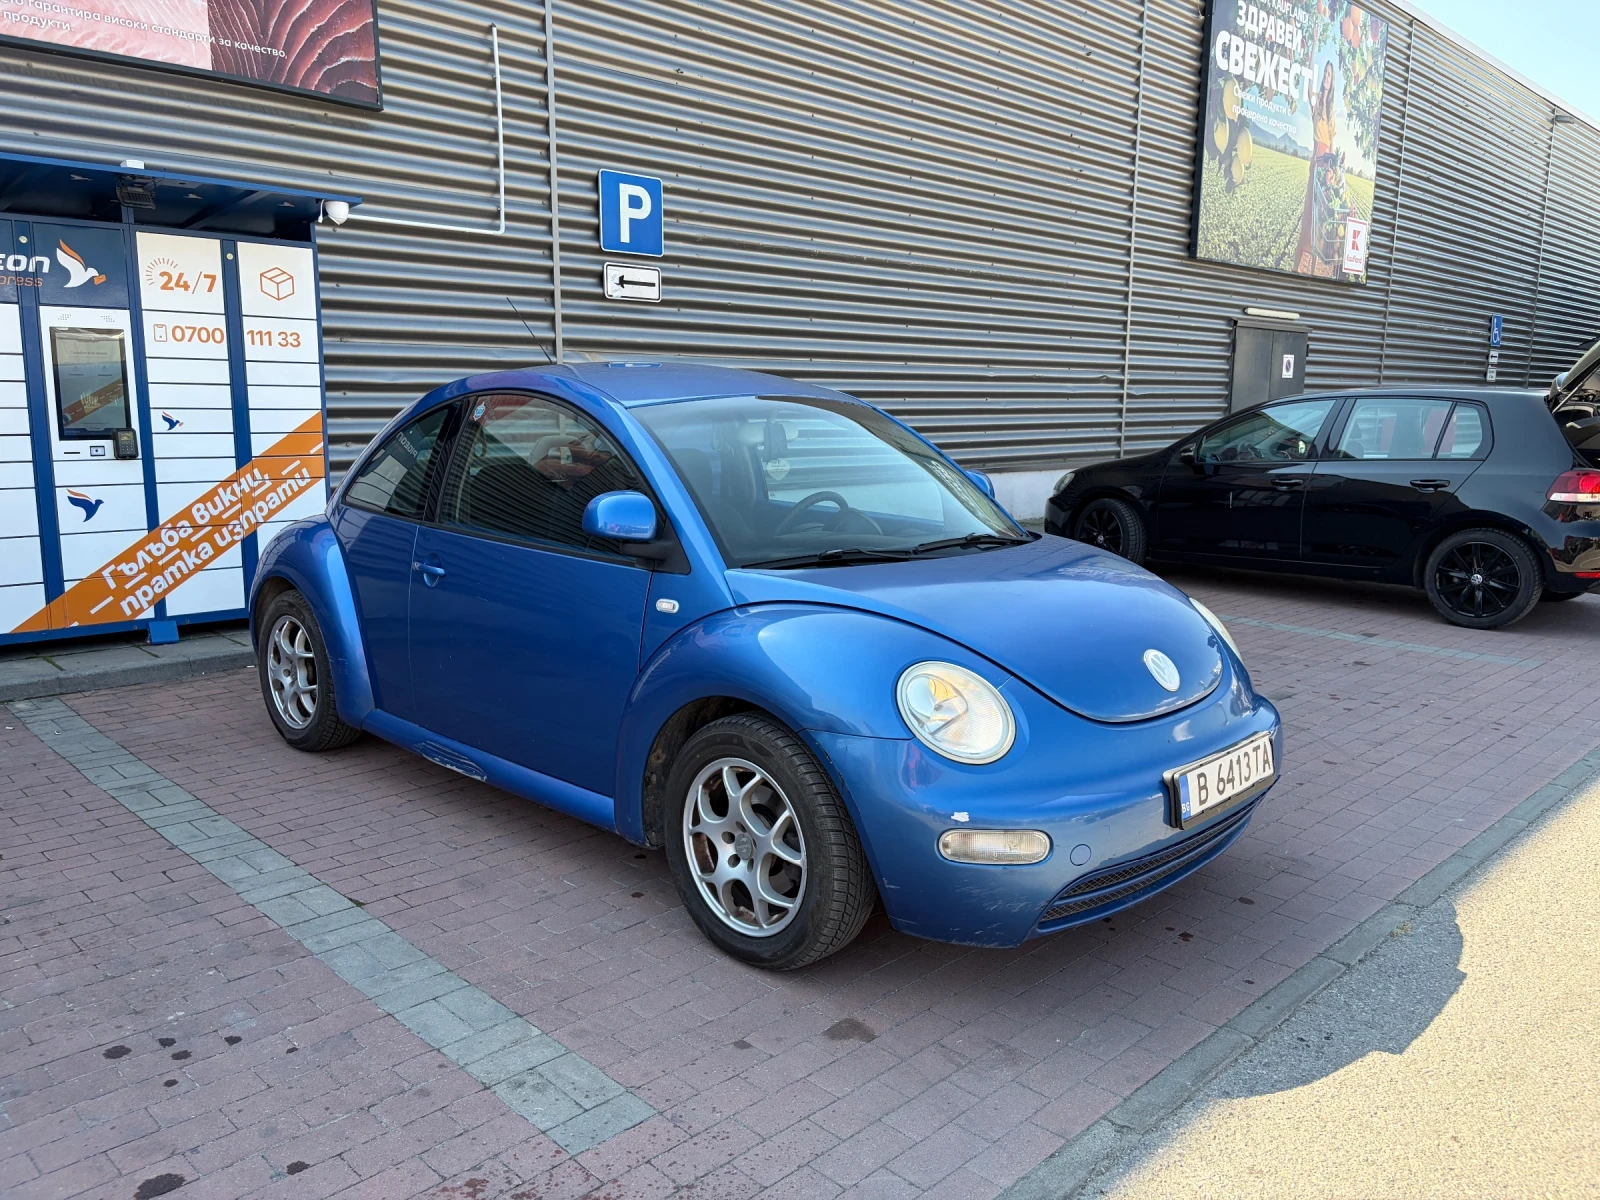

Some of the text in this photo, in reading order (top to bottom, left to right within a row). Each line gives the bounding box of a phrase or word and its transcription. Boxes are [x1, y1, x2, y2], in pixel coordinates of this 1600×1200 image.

[3, 11, 75, 31] продукти.
[28, 0, 101, 21] гарантира
[104, 15, 148, 31] високи
[152, 25, 216, 44] стандарти
[219, 37, 232, 47] за
[234, 41, 288, 60] качество,
[1236, 0, 1304, 58] ЗДРАВЕЙ,
[1215, 30, 1319, 107] СВЕЖЕСТ!
[1233, 85, 1256, 102] Свежи
[1256, 97, 1287, 114] продукти
[1232, 104, 1297, 134] проверено качество
[619, 183, 652, 243] P
[159, 271, 217, 294] 24/7
[171, 325, 302, 348] 0700 111 33
[101, 520, 193, 589] Гълъба
[120, 466, 311, 617] пратка изпрати
[1197, 771, 1209, 806] B
[1181, 801, 1191, 813] BG
